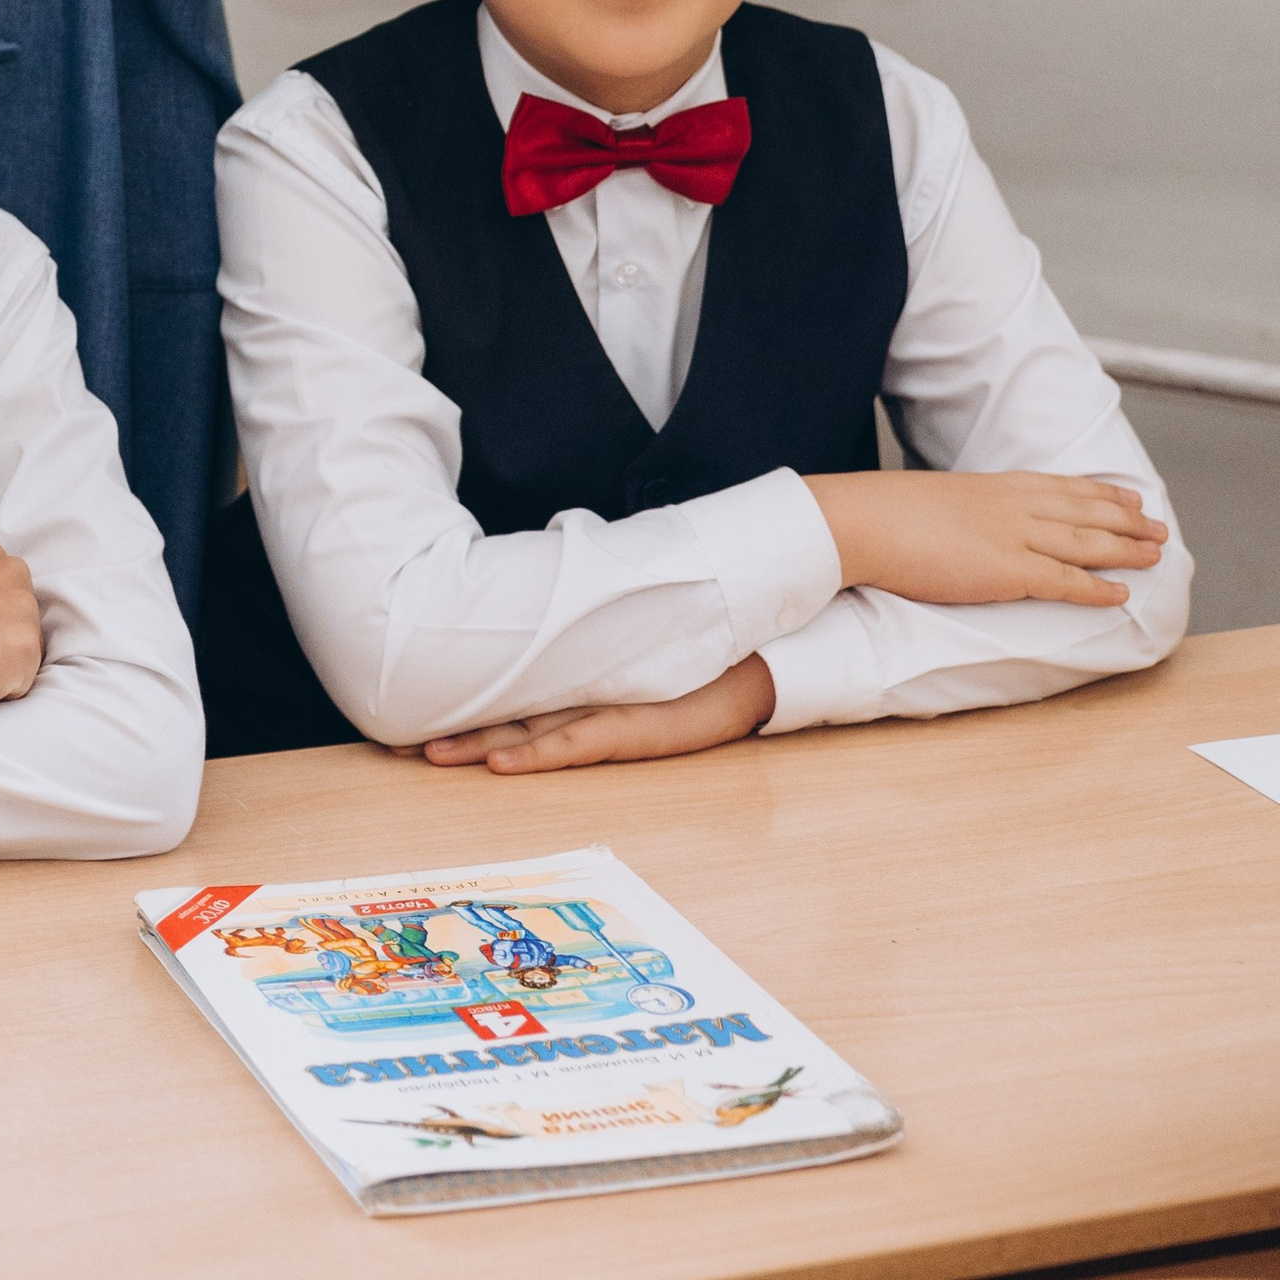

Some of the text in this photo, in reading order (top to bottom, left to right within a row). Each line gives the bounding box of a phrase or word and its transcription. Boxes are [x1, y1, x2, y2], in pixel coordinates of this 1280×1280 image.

[297, 880, 479, 904] ДРОФА Астрель
[193, 899, 231, 925] ФГОС
[361, 901, 429, 914] Часть 2
[467, 1003, 512, 1014] класс
[471, 1011, 527, 1038] 4
[305, 1012, 773, 1088] Математика
[540, 1100, 656, 1124] знаний
[541, 1109, 684, 1135] Планета
